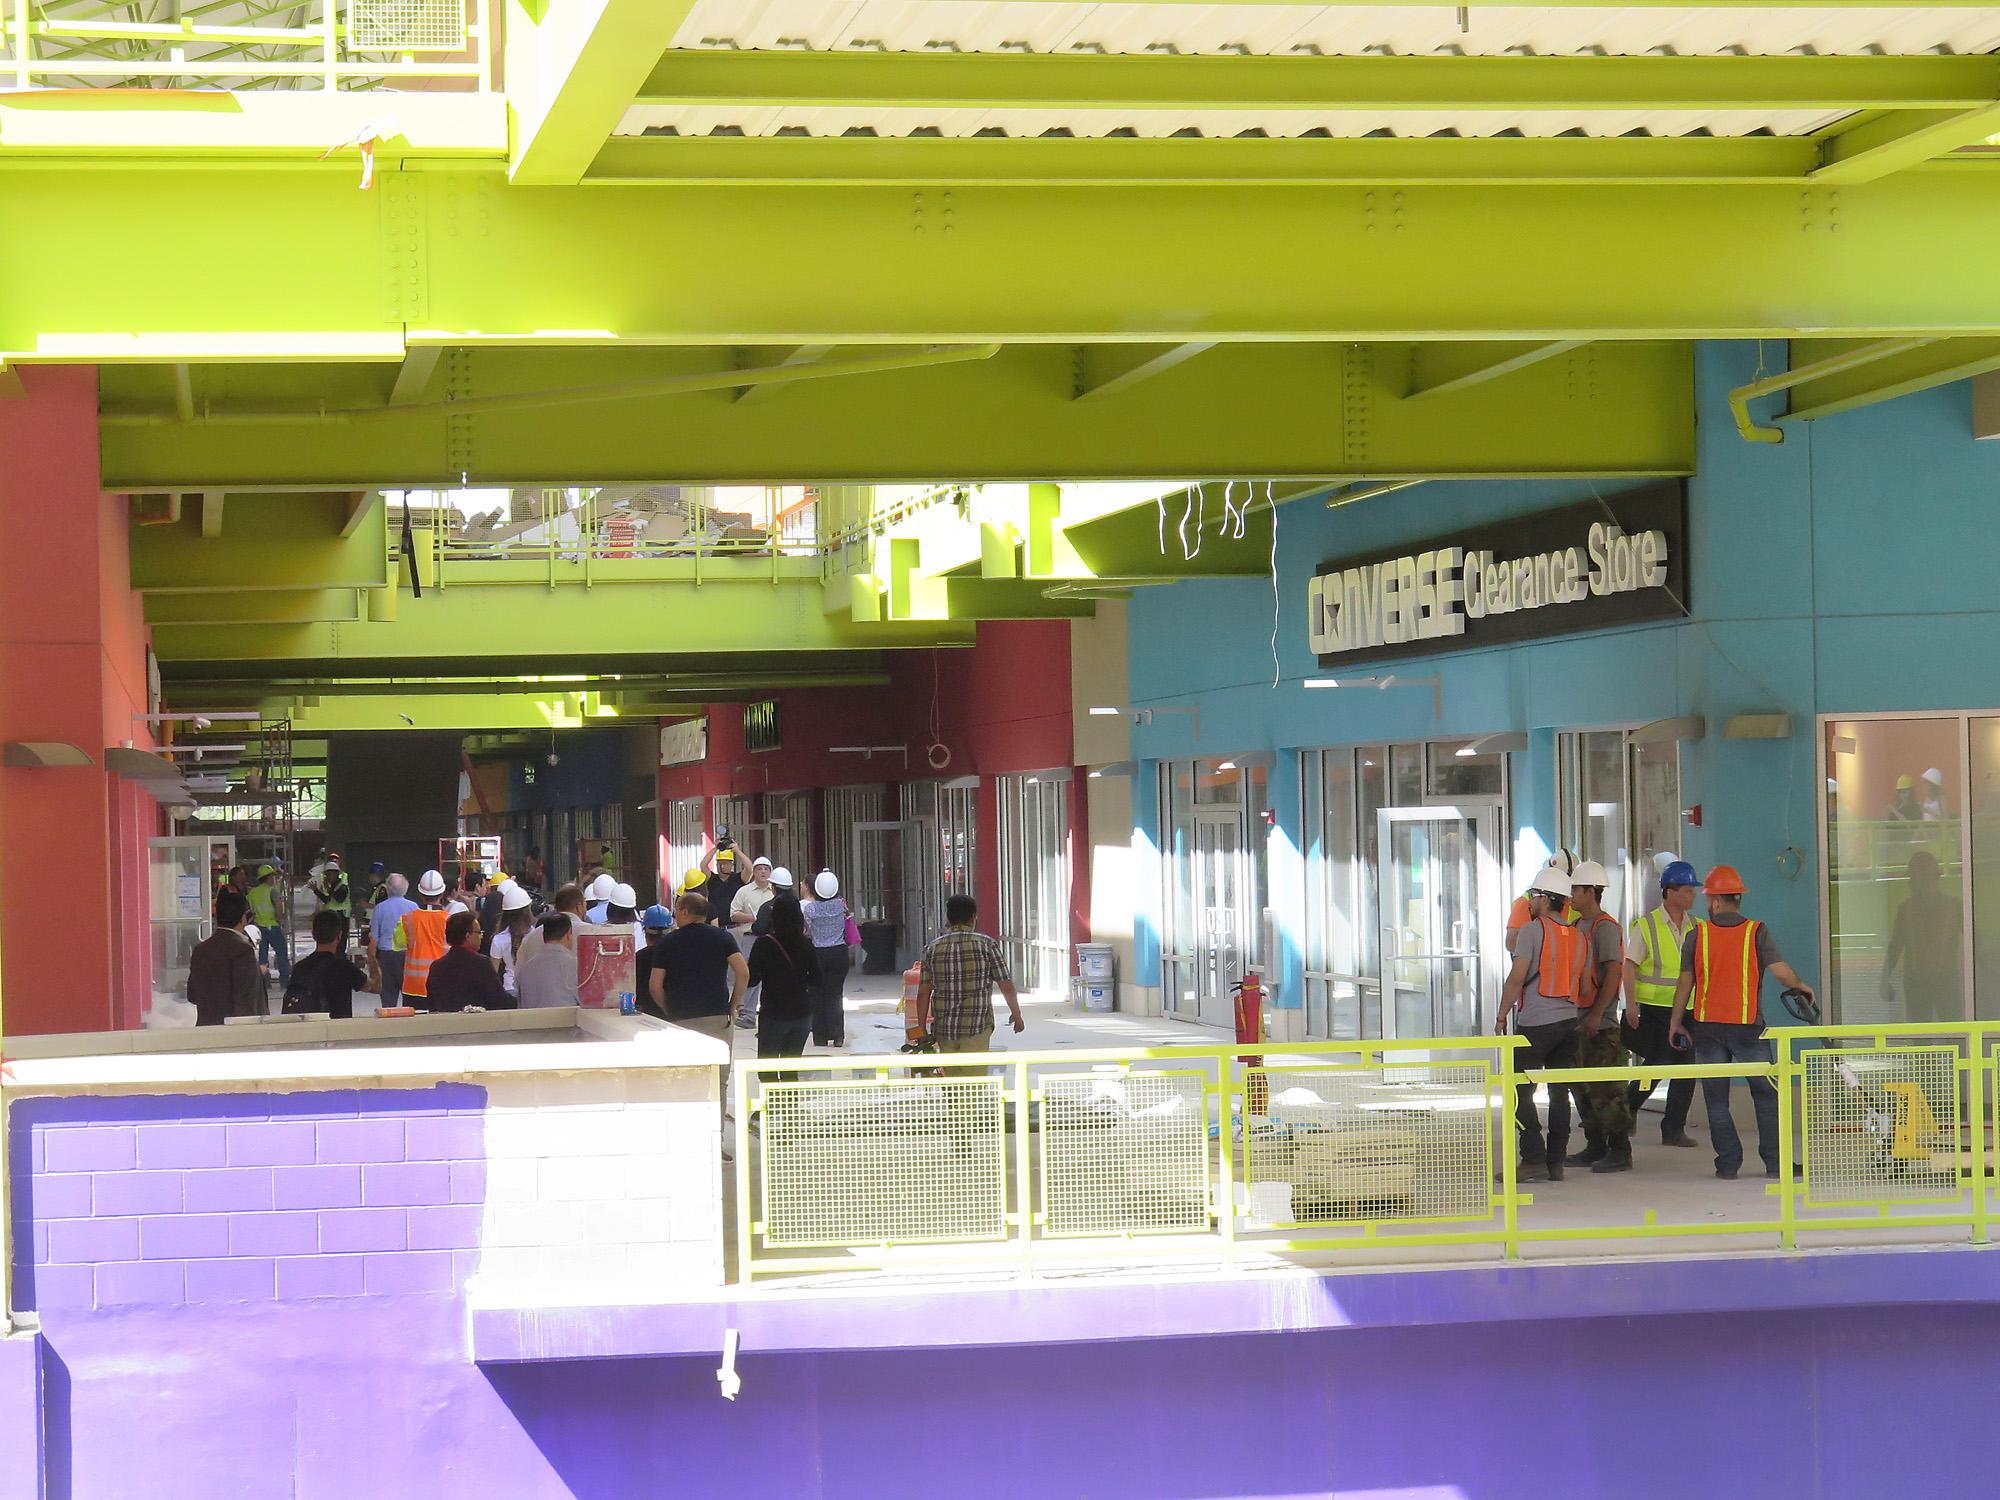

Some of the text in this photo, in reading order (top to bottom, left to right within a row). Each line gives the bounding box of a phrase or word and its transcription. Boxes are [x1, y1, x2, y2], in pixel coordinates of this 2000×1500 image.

[1308, 522, 1668, 654] CONVERSE Clearance Store
